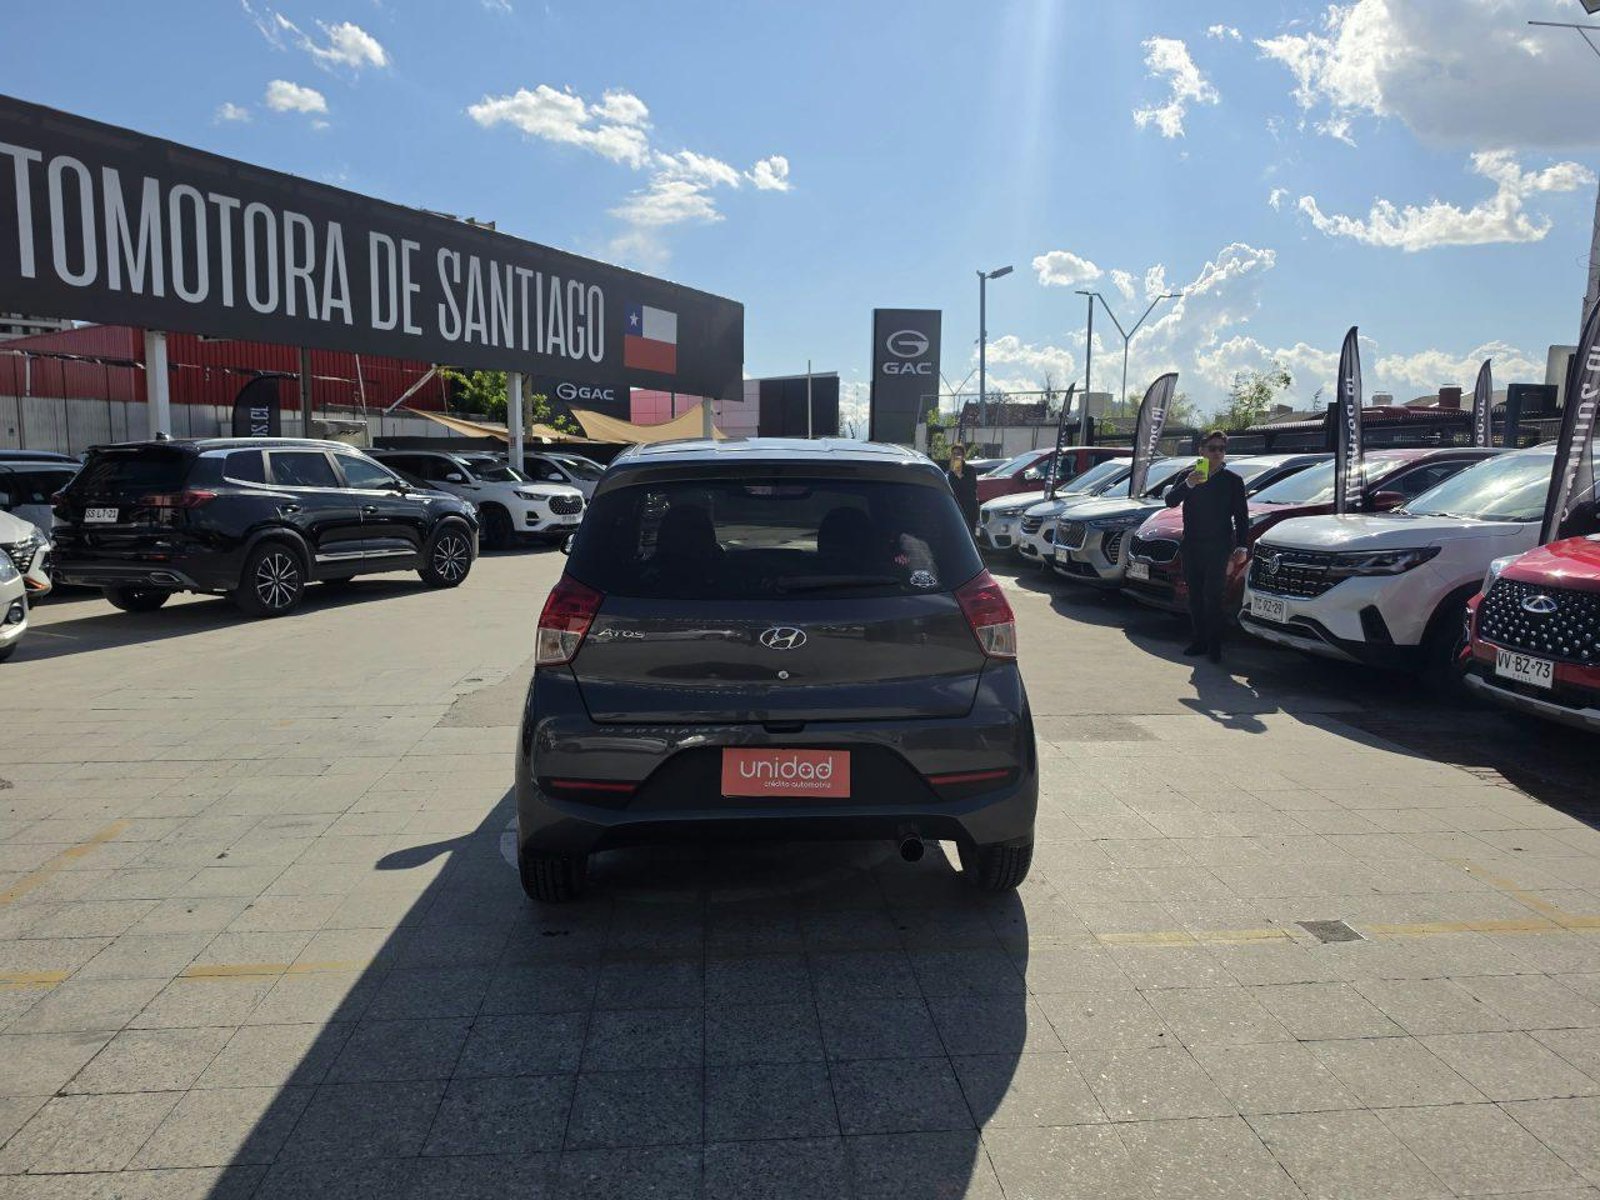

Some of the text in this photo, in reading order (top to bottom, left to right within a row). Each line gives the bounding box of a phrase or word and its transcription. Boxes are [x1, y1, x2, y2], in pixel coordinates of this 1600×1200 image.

[0, 142, 606, 364] TOMOTORA DE SANTIAGO
[882, 362, 932, 375] GAC
[578, 387, 615, 400] GAC
[740, 755, 833, 779] unidad
[792, 780, 832, 789] automotriz
